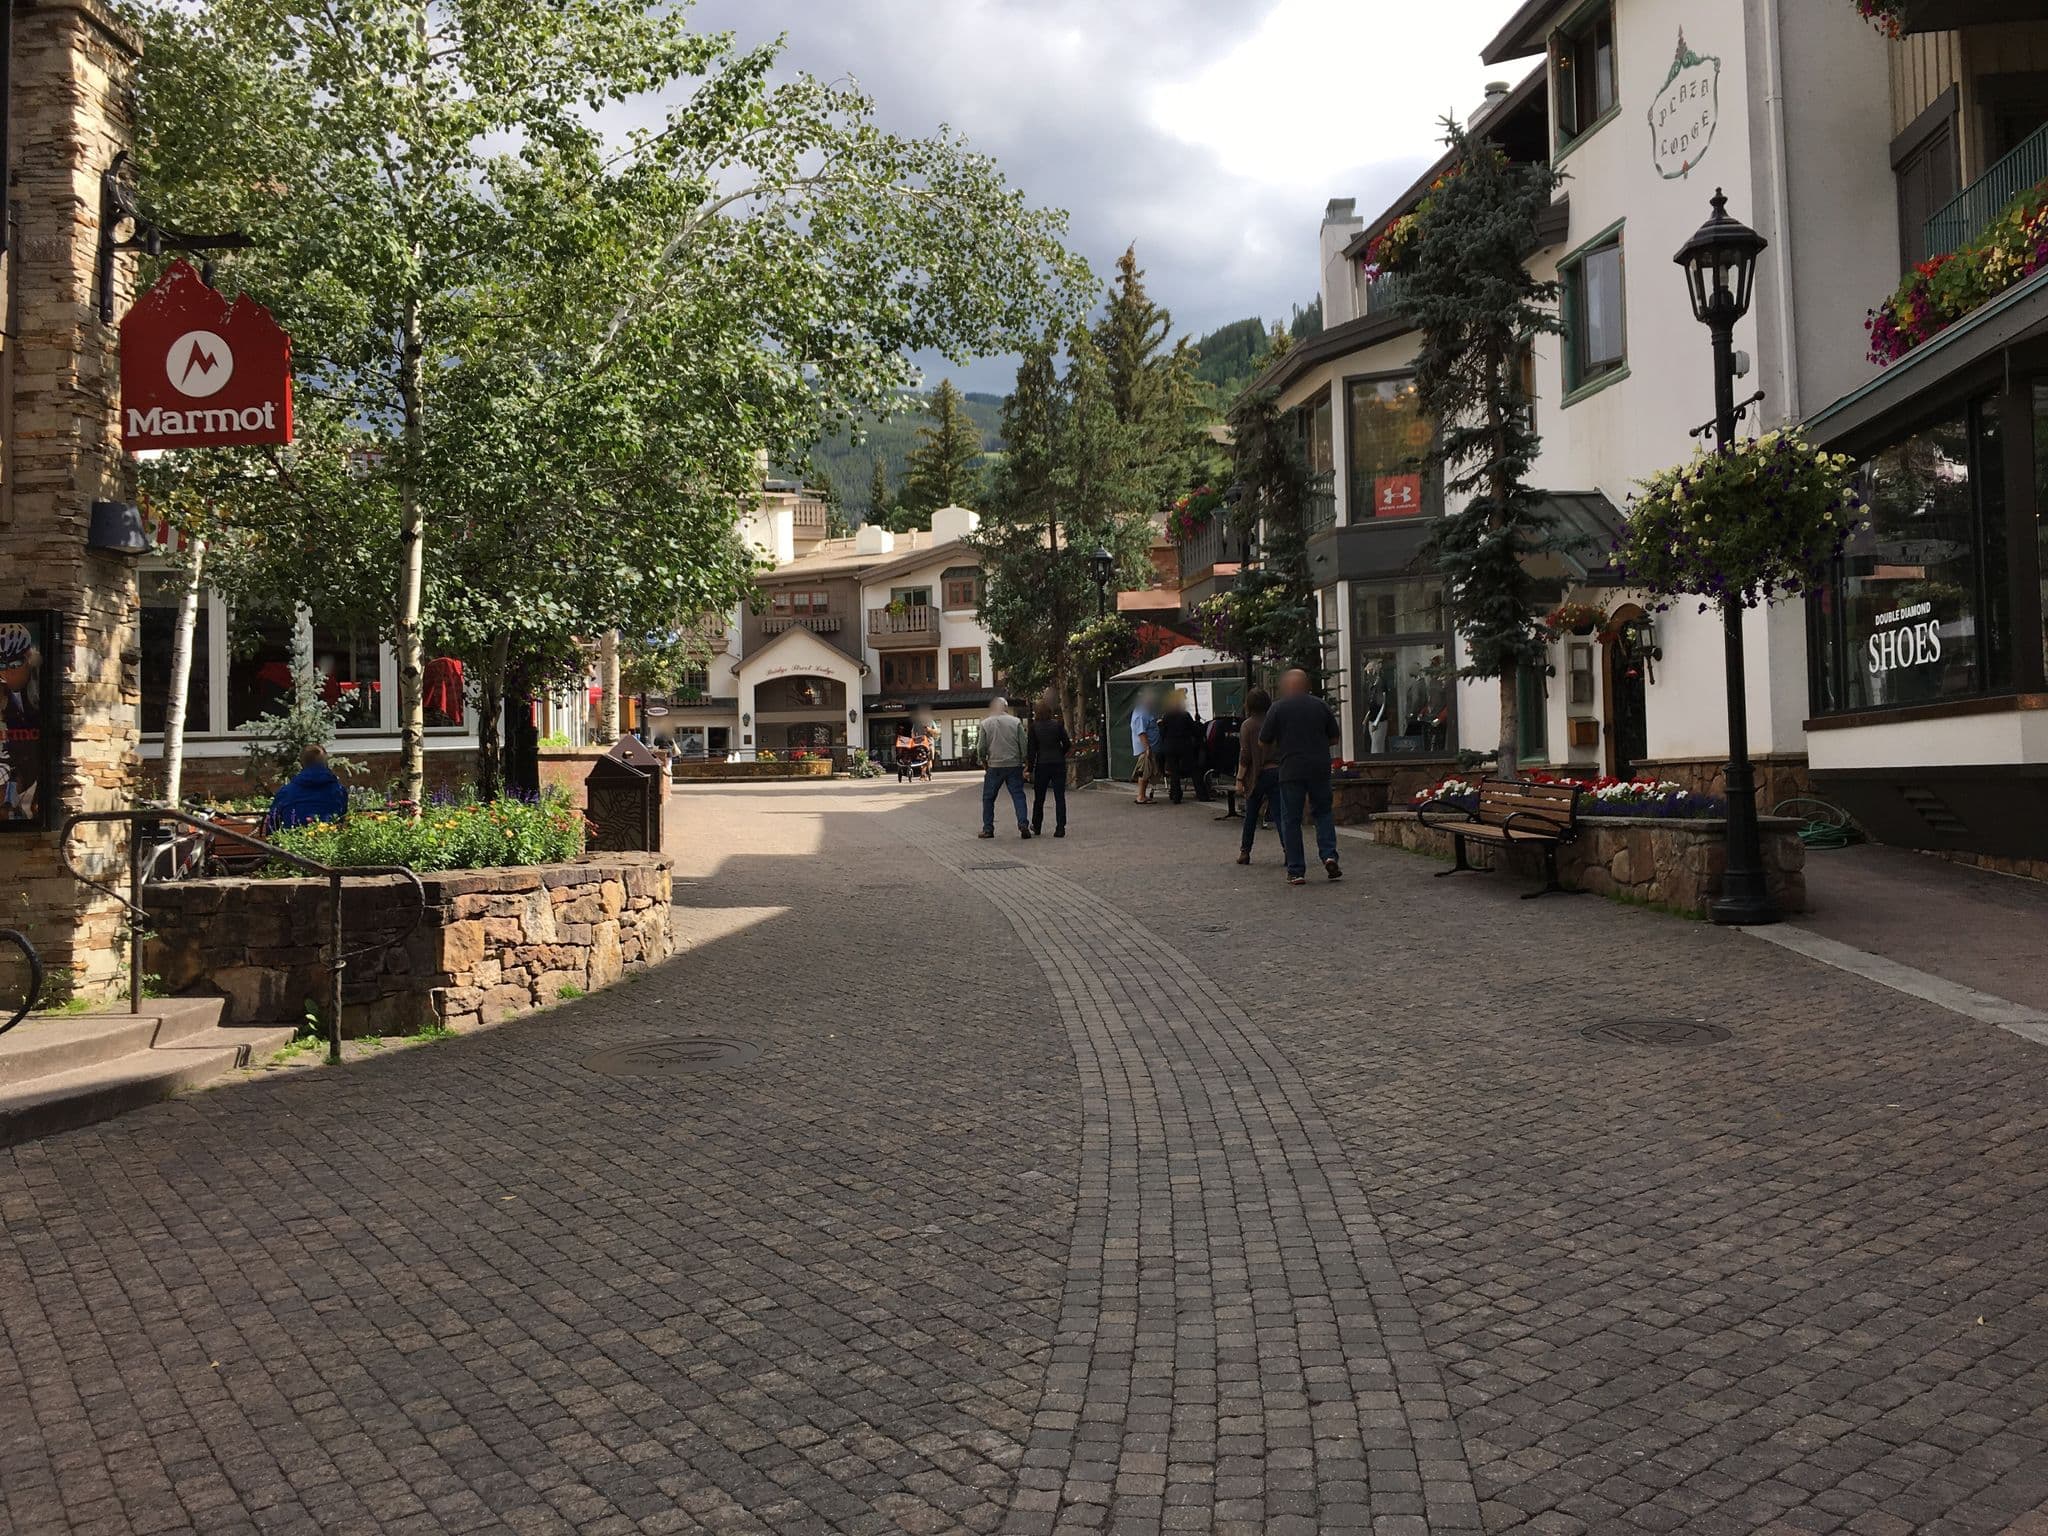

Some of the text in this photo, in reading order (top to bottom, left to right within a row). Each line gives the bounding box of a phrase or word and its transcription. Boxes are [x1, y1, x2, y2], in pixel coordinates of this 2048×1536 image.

[1659, 79, 1709, 127] PLAZA
[1661, 110, 1709, 156] LODGE
[126, 401, 276, 437] Marmot
[1875, 601, 1931, 626] DOUBLE DIAMOND
[1869, 619, 1941, 673] SHOES
